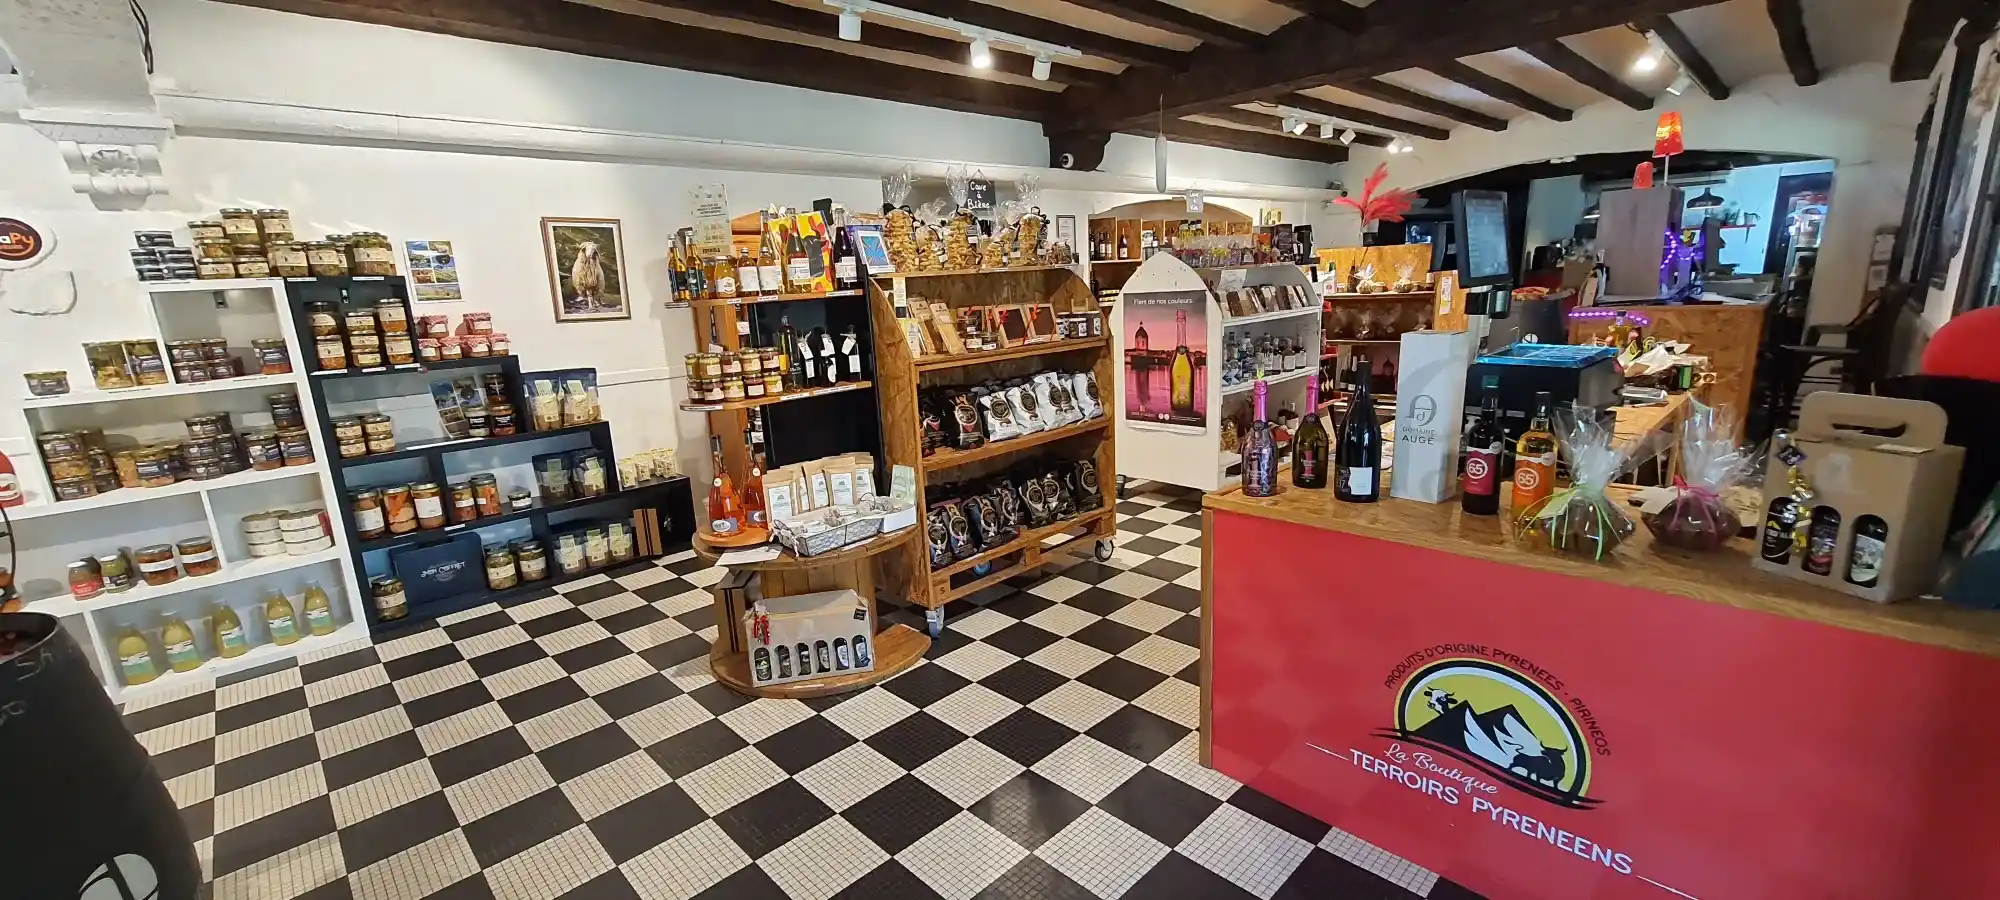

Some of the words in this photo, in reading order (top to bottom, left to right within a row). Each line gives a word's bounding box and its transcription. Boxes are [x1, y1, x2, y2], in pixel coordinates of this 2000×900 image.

[970, 181, 987, 191] Cave
[1133, 298, 1147, 306] Fiers
[1469, 462, 1484, 475] 65
[1519, 472, 1535, 485] 65
[1384, 651, 1424, 690] PRODUITS
[1424, 642, 1489, 657] D'ORIGINE
[1492, 648, 1564, 691] PYRENEES
[1568, 697, 1611, 757] PIRINEOS
[1384, 743, 1410, 764] La
[1412, 752, 1498, 793] Boutique
[1349, 748, 1460, 805] TERROIRS
[1471, 797, 1634, 875] PYRENEENS
